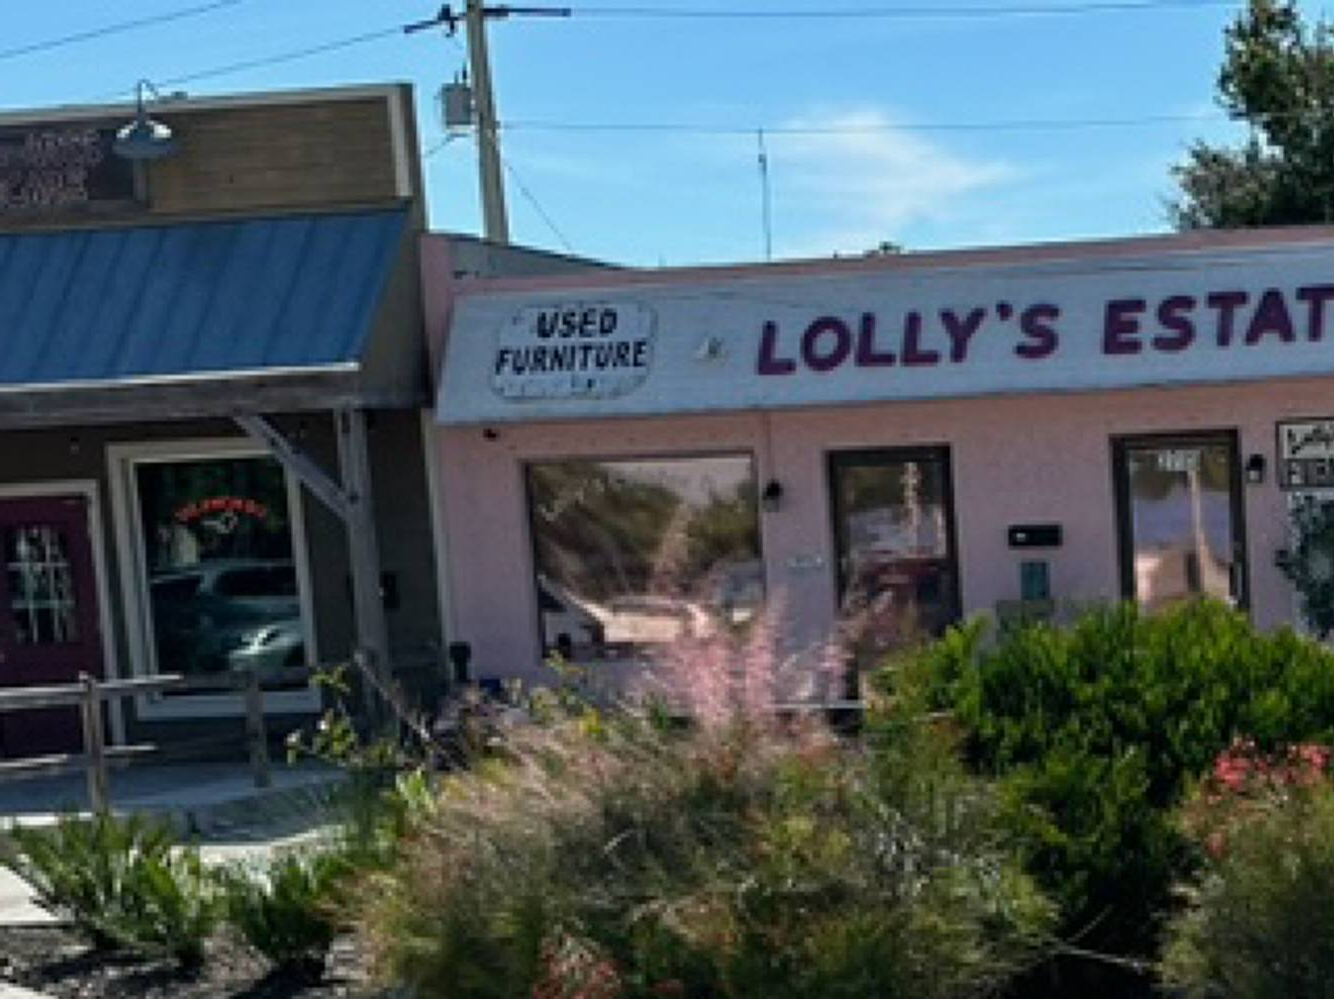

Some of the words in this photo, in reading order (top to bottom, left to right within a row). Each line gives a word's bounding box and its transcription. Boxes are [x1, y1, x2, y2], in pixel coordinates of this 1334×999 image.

[537, 308, 618, 338] USED
[757, 301, 1062, 376] LOLLY'S
[495, 340, 647, 375] FURNITURE
